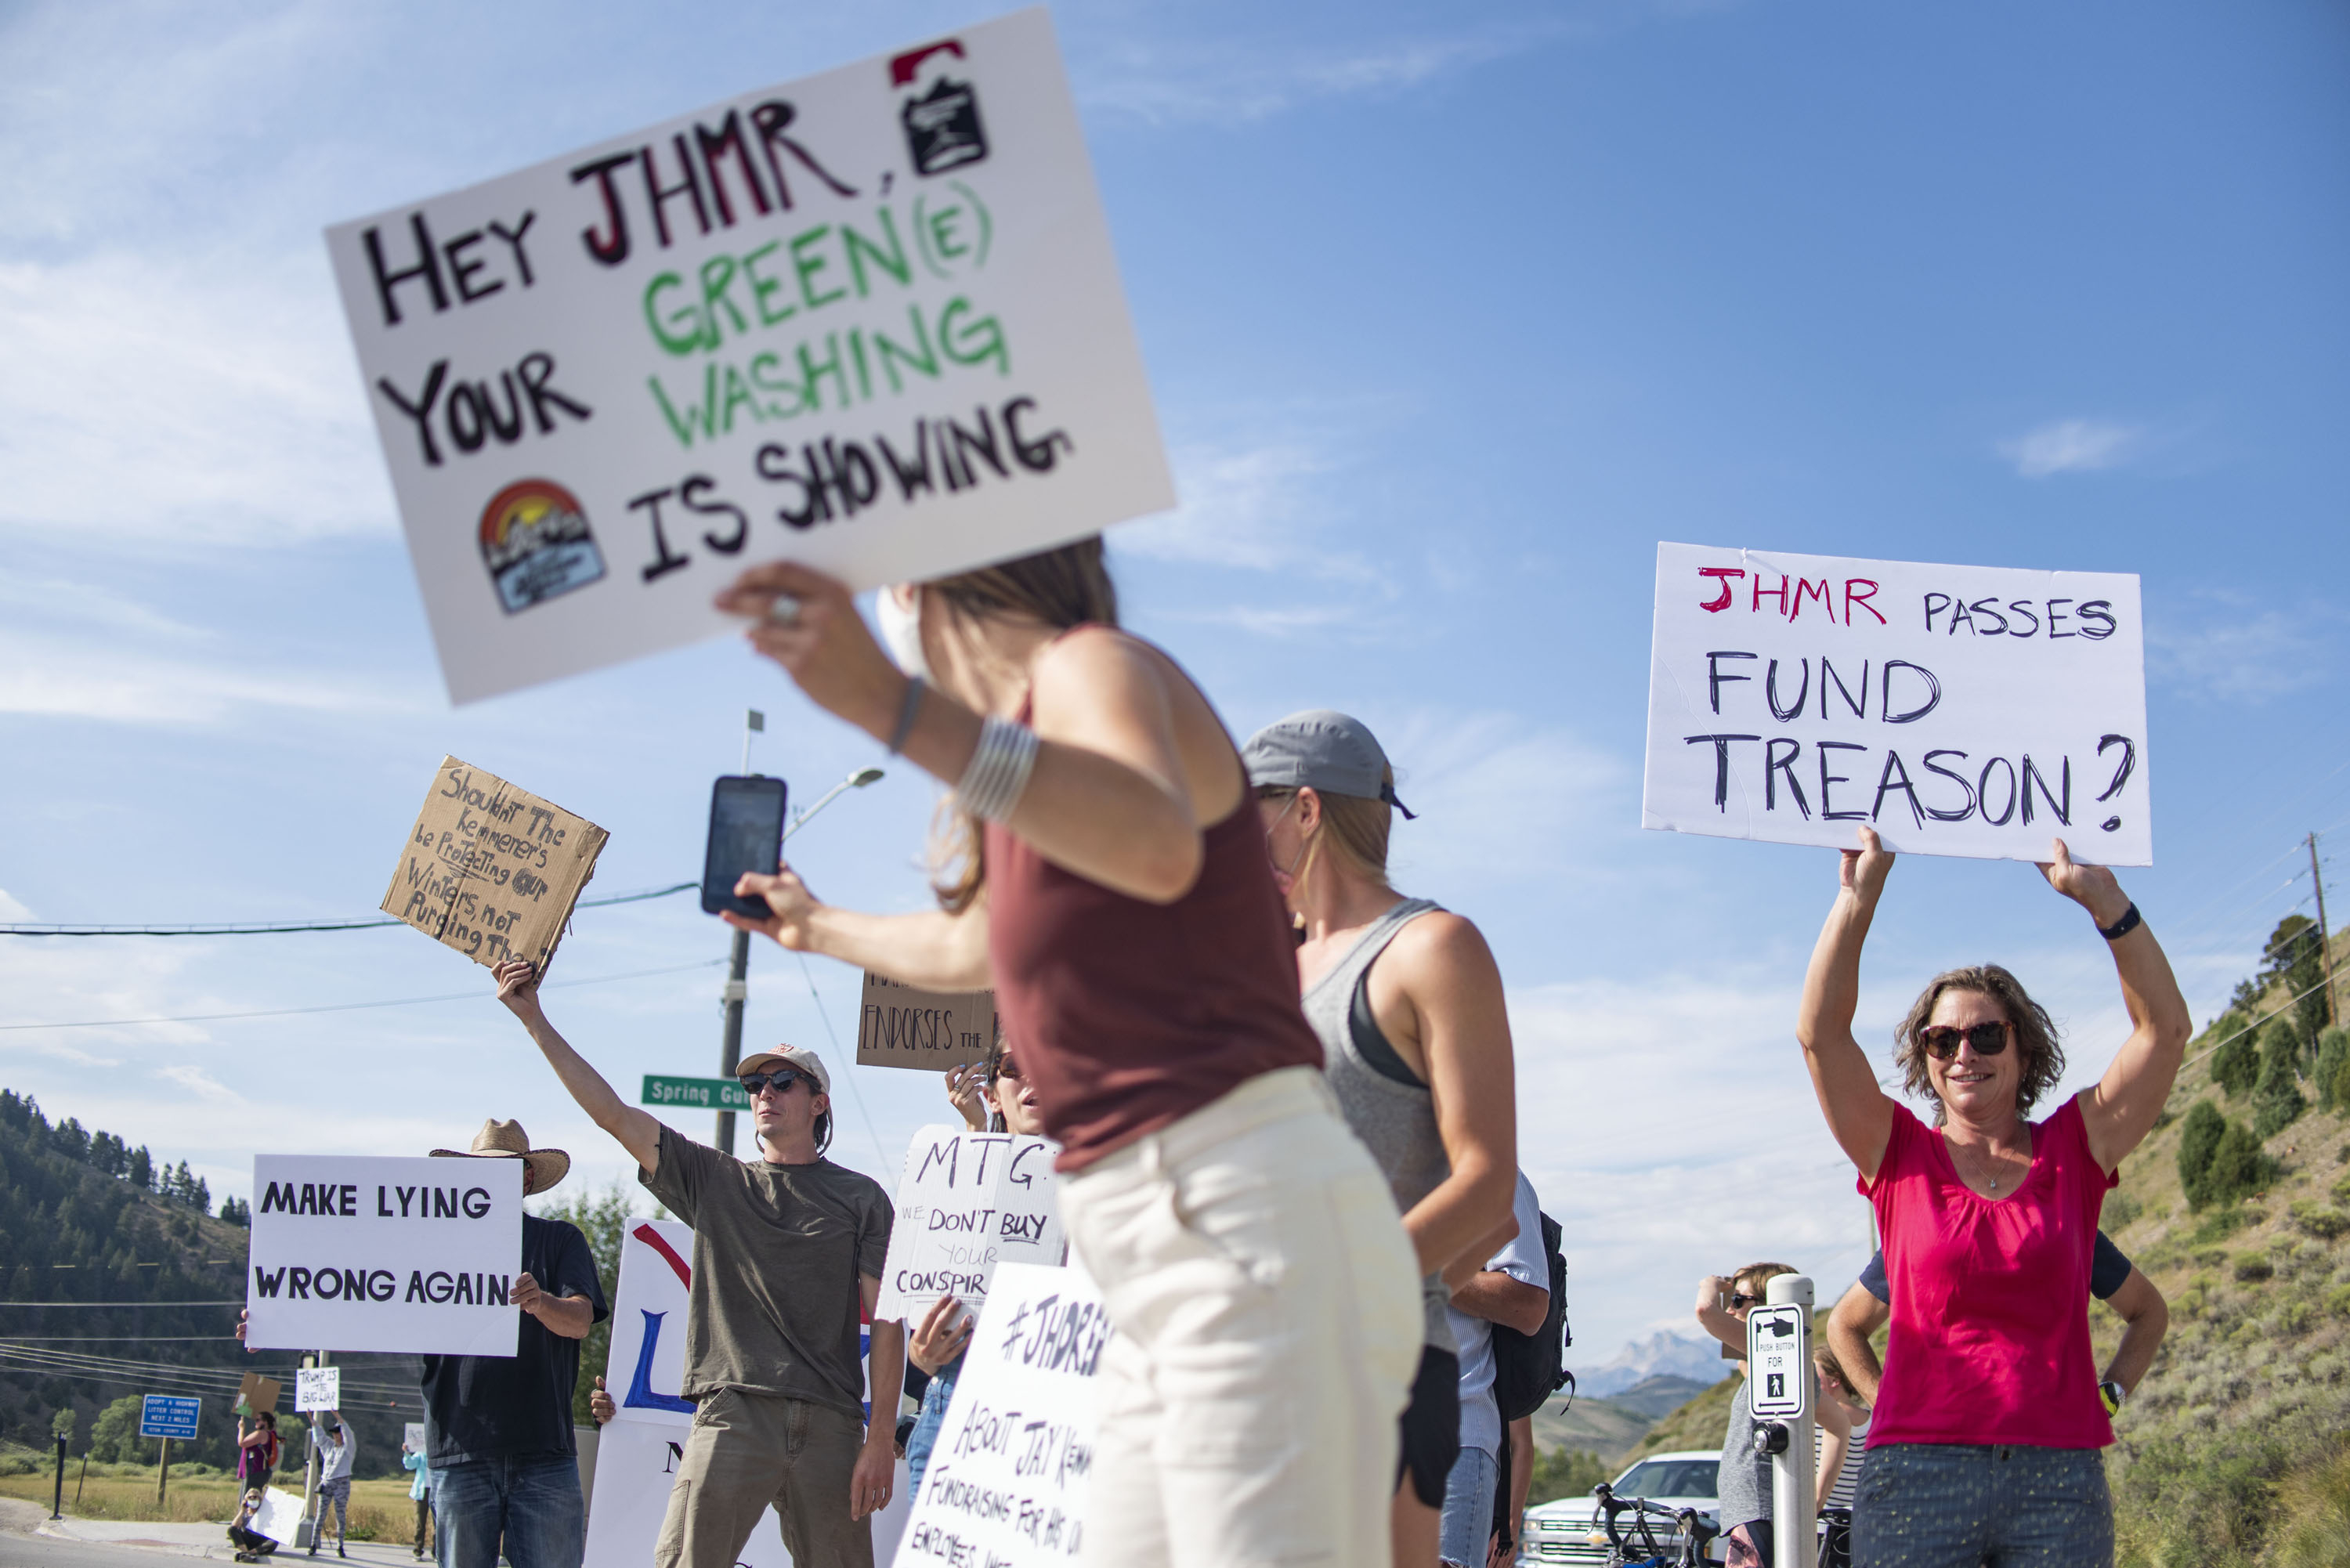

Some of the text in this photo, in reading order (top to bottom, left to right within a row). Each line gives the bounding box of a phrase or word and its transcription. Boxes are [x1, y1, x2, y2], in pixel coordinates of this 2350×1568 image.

[361, 210, 536, 327] HEY
[648, 295, 1010, 449] WASHING
[378, 351, 594, 467] YOUR
[627, 473, 748, 584] IS
[756, 397, 1073, 530] SHOWING
[1698, 568, 2117, 641] JHMR PASSES
[1706, 652, 1941, 723] FUND
[1683, 734, 2136, 833] TREASON?
[414, 823, 434, 847] be
[456, 806, 548, 868] Kemmerer's
[526, 805, 566, 846] The
[863, 1005, 982, 1050] ENDORSES THE
[652, 1081, 710, 1105] Spring
[260, 1181, 491, 1219] MAKE LYING
[902, 1206, 1047, 1240] WE DON'T BUY
[939, 1244, 998, 1266] YOUR
[255, 1266, 509, 1306] WRONG AGAIN
[1759, 1342, 1795, 1352] PUSH BUTTON
[1768, 1357, 1783, 1367] FOR
[298, 1370, 337, 1384] TRUMP IS
[302, 1392, 317, 1403] BIG
[953, 1400, 1021, 1459] ABOUT
[1016, 1421, 1063, 1476] JAY
[926, 1465, 1014, 1523] FUNDRAISING
[1016, 1498, 1044, 1548] FOR
